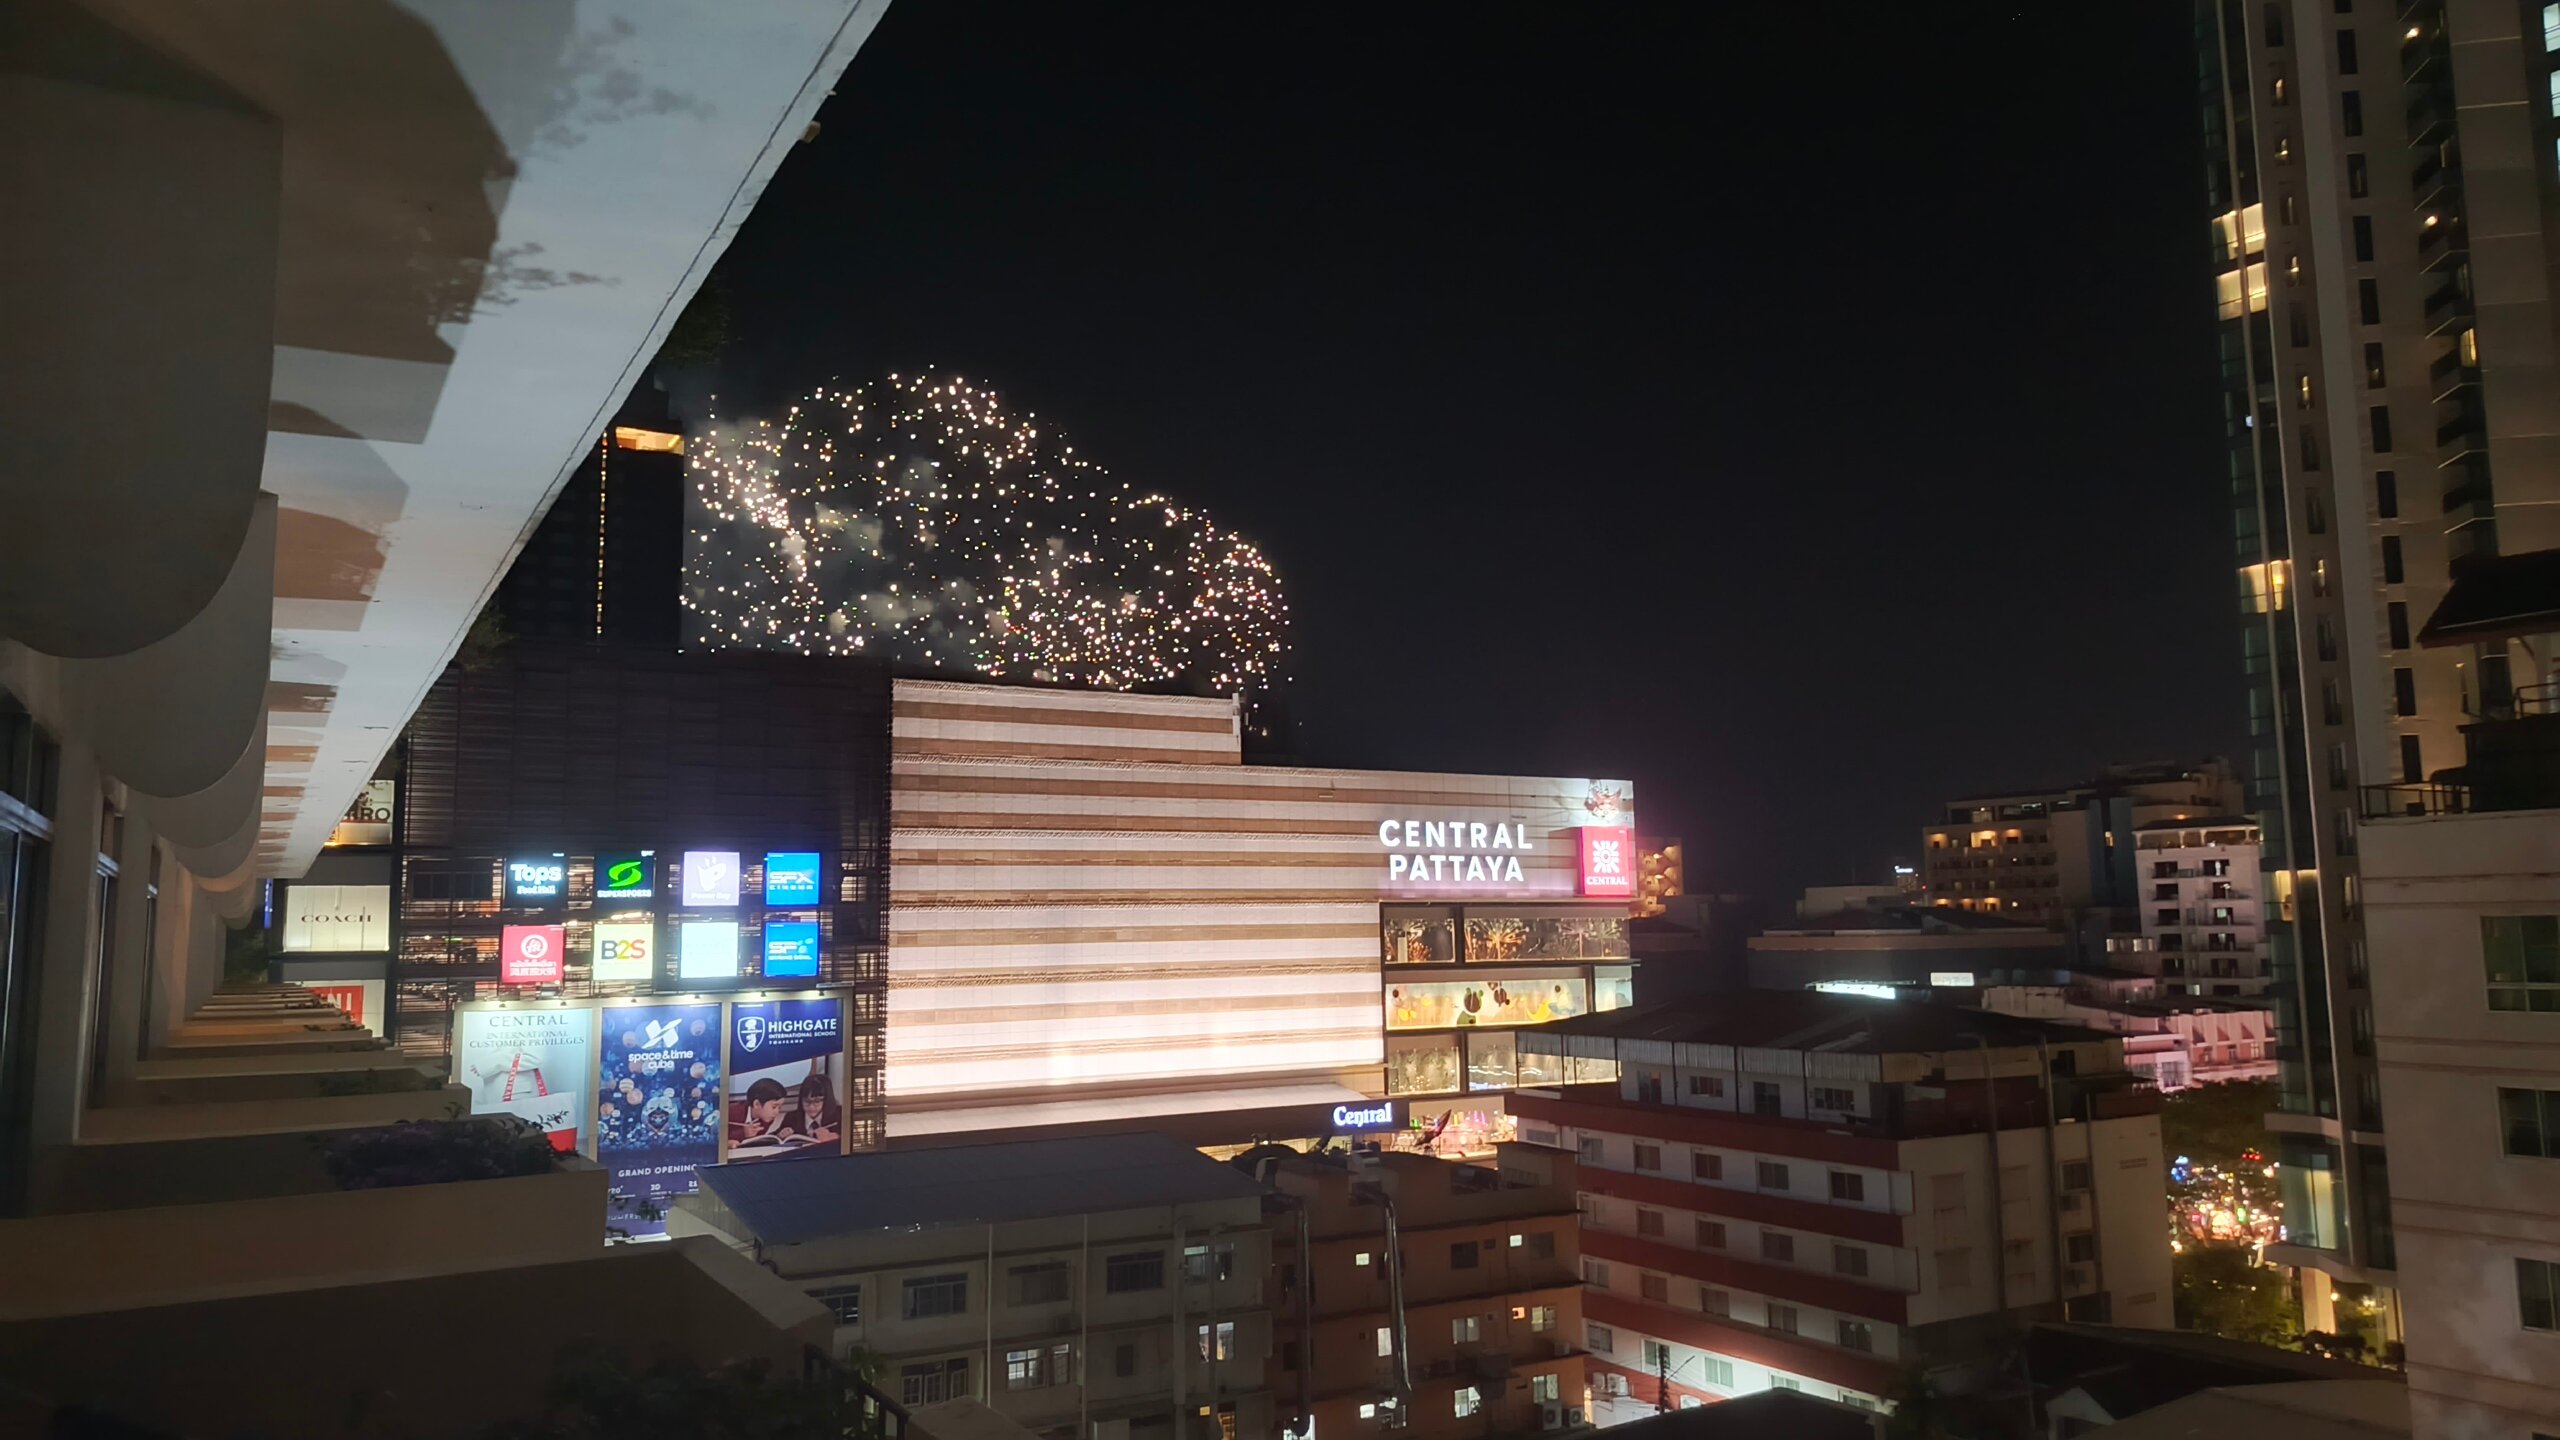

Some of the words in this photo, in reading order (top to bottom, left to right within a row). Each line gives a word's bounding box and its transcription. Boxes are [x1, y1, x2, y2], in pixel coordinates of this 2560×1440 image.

[1379, 819, 1533, 850] CENTRAL
[509, 863, 562, 885] Tops
[1389, 854, 1525, 882] PATTAYA
[1586, 876, 1628, 886] CENTRAL
[597, 889, 652, 898] SUPERSPORTS
[301, 914, 371, 923] COACH
[601, 939, 646, 961] B2S
[489, 1014, 568, 1028] CENTRAL
[768, 1018, 837, 1033] HIGHGATE
[486, 1029, 569, 1040] INTERNATIONAL
[469, 1039, 526, 1049] CUSTOMER
[528, 1036, 585, 1047] PRIVILEGES
[648, 1059, 675, 1069] cube
[1333, 1102, 1392, 1127] Central
[618, 1168, 651, 1178] GRAND
